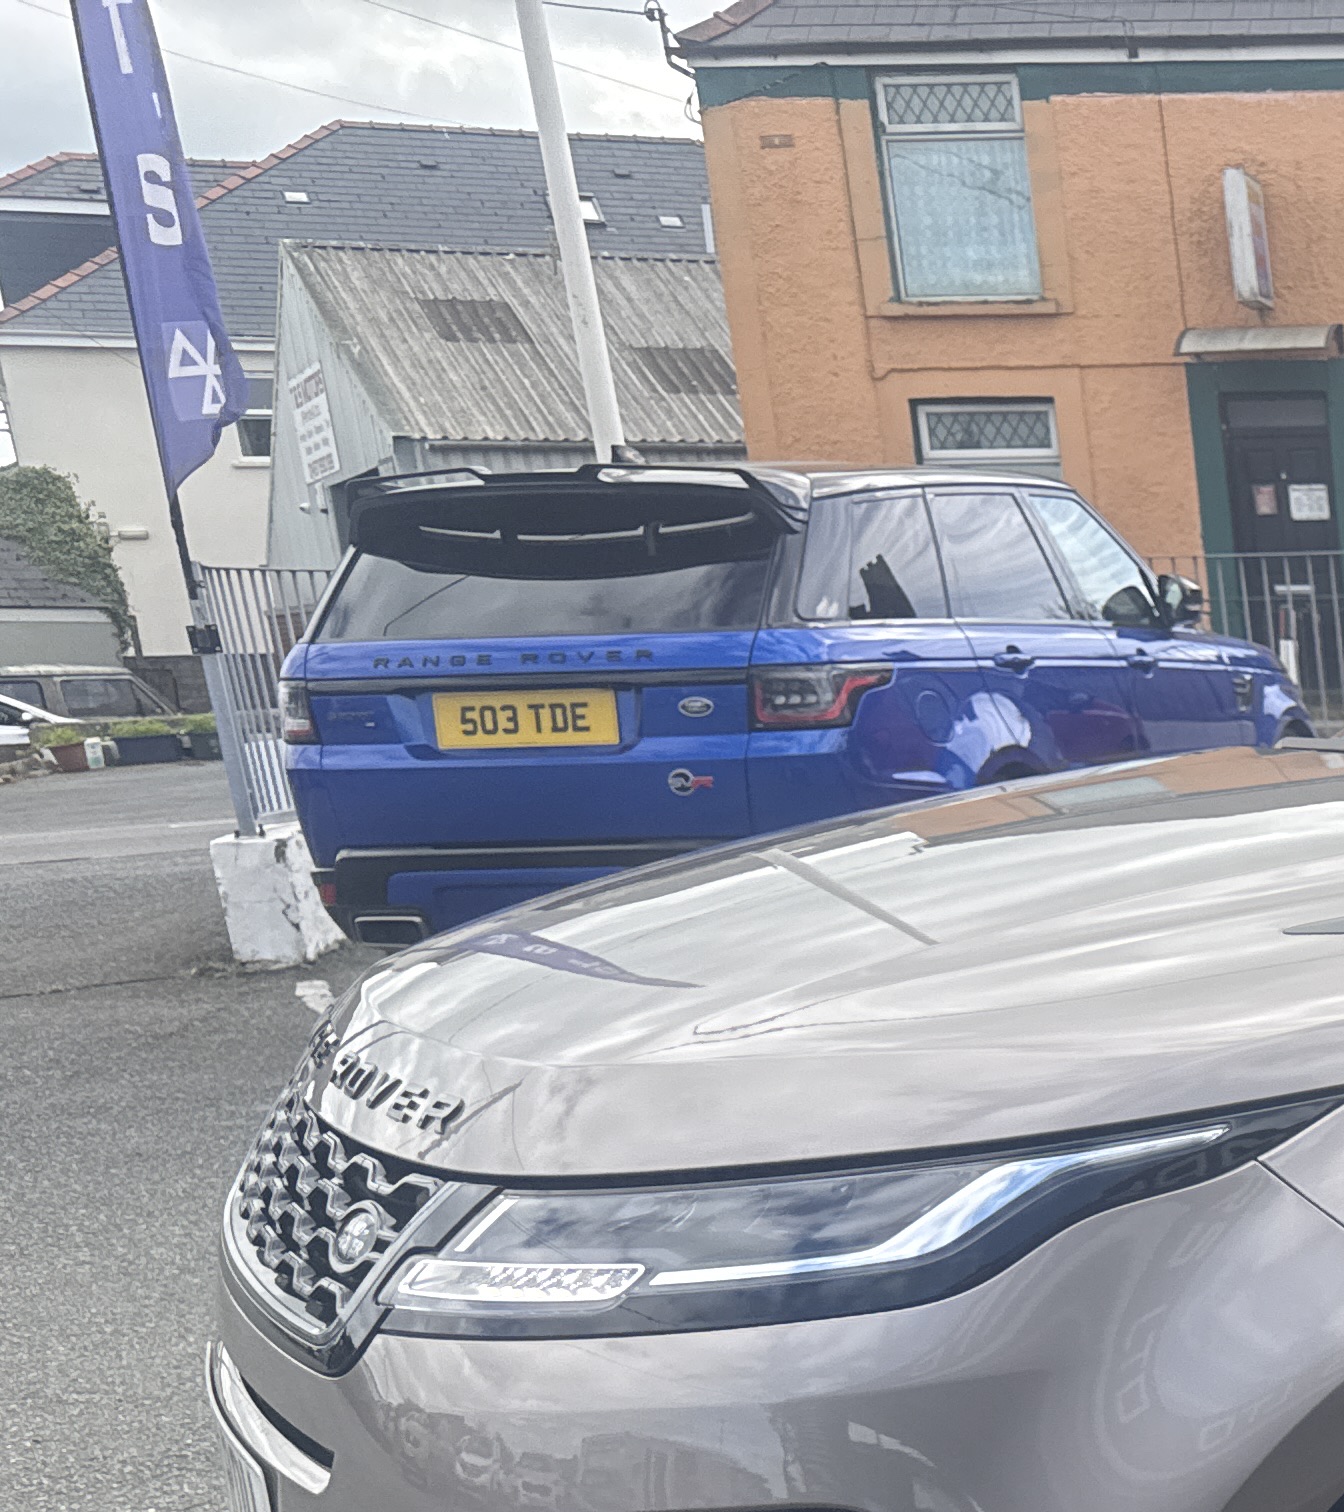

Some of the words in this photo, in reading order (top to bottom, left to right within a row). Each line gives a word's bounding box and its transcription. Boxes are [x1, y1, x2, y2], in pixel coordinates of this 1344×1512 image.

[373, 653, 493, 669] RANGE
[519, 649, 653, 665] ROVER
[459, 703, 519, 736] 503
[528, 702, 591, 734] TDE
[330, 1052, 466, 1136] ROVER
